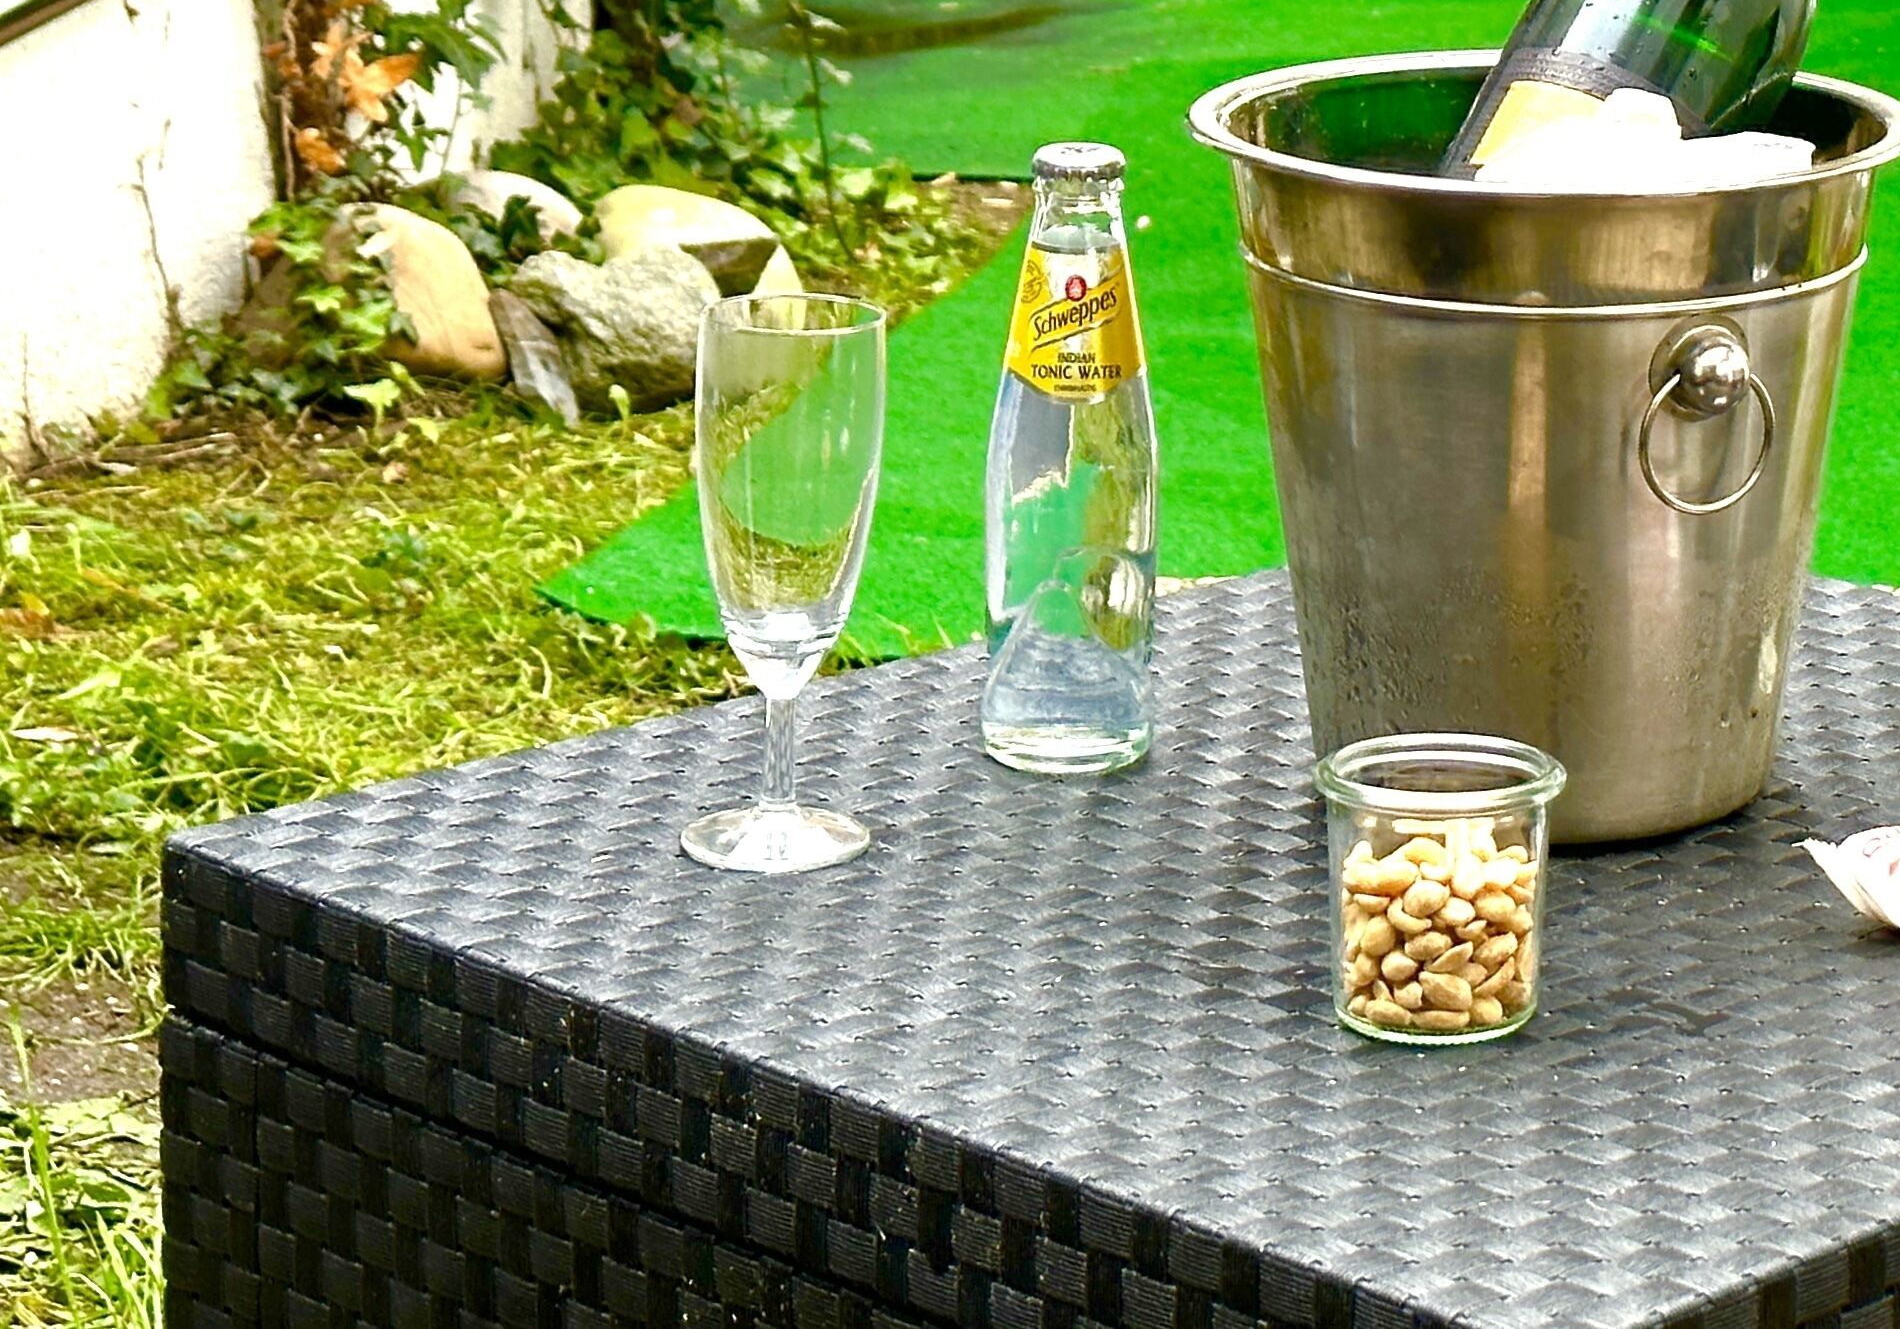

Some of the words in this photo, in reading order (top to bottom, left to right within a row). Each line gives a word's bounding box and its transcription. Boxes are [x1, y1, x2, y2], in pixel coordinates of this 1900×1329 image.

[1033, 287, 1117, 341] Schweppes
[1057, 352, 1096, 364] INDIAN
[1031, 364, 1073, 380] TONIC
[1078, 364, 1122, 380] WATER
